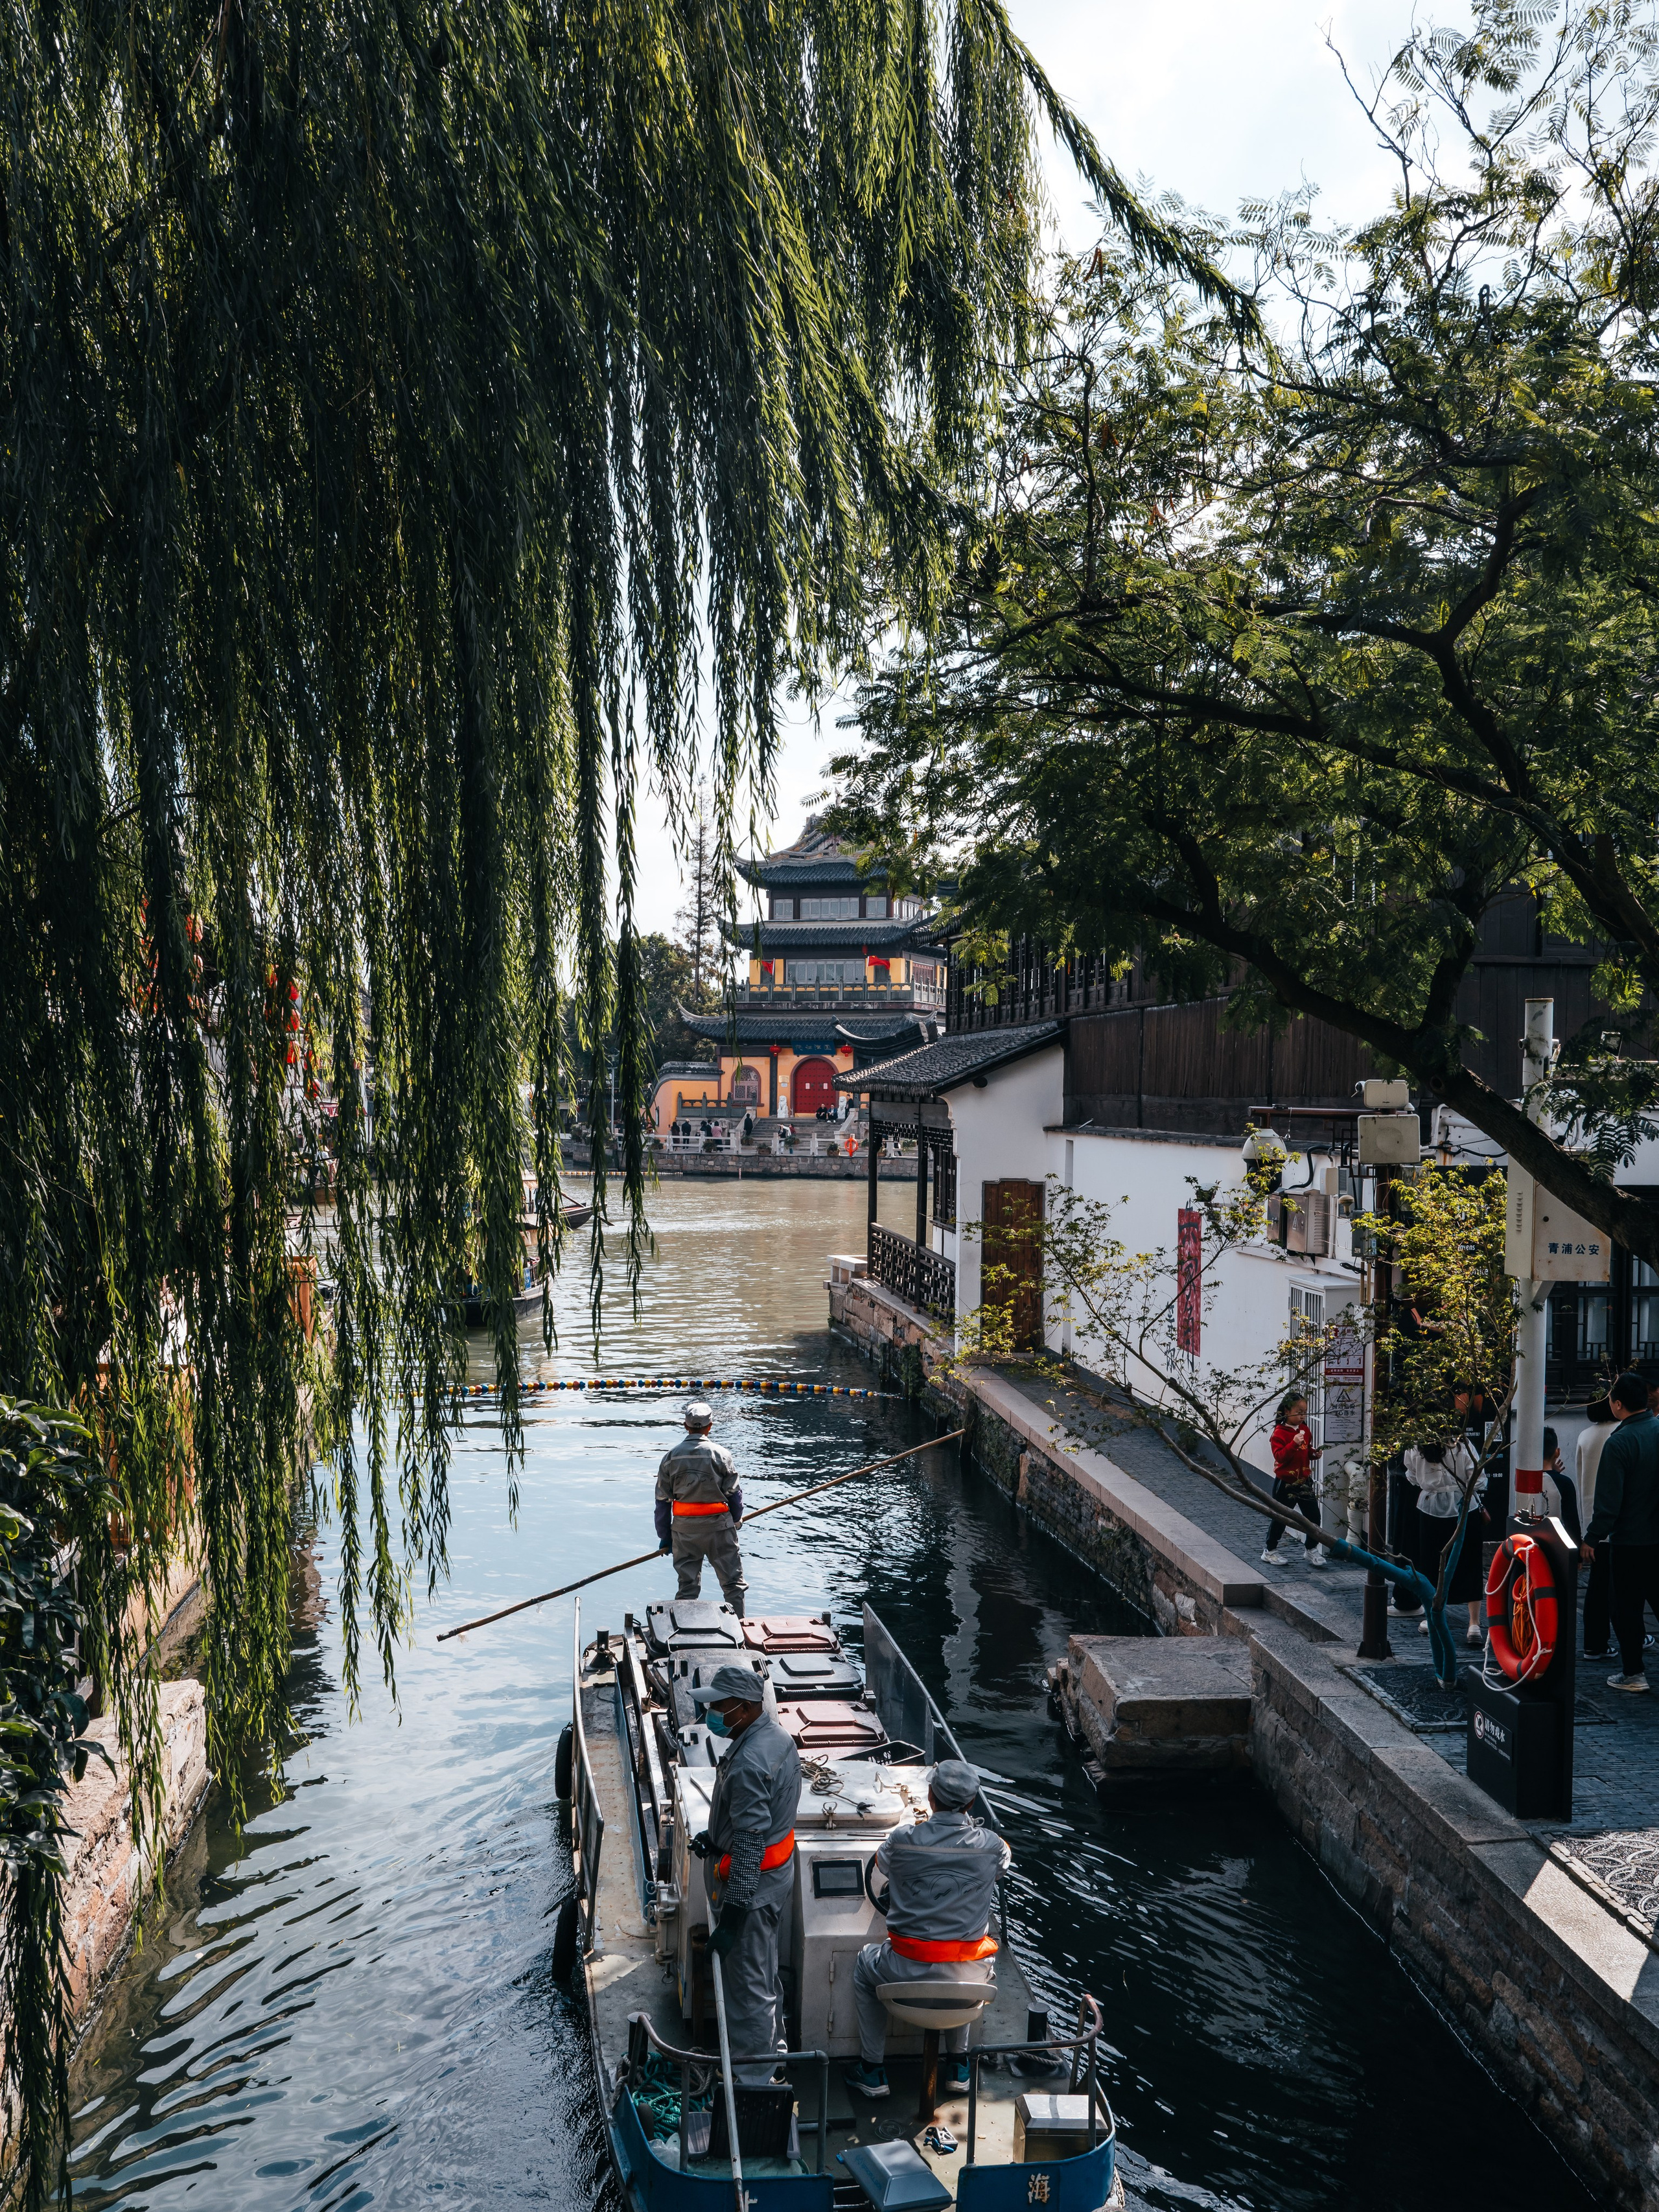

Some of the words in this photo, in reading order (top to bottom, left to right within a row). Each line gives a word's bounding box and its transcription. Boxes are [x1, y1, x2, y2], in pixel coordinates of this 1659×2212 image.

[1548, 1242, 1599, 1255] 青浦公安
[1485, 1717, 1505, 1742] 请勿戏水
[1027, 2172, 1051, 2204] 海
